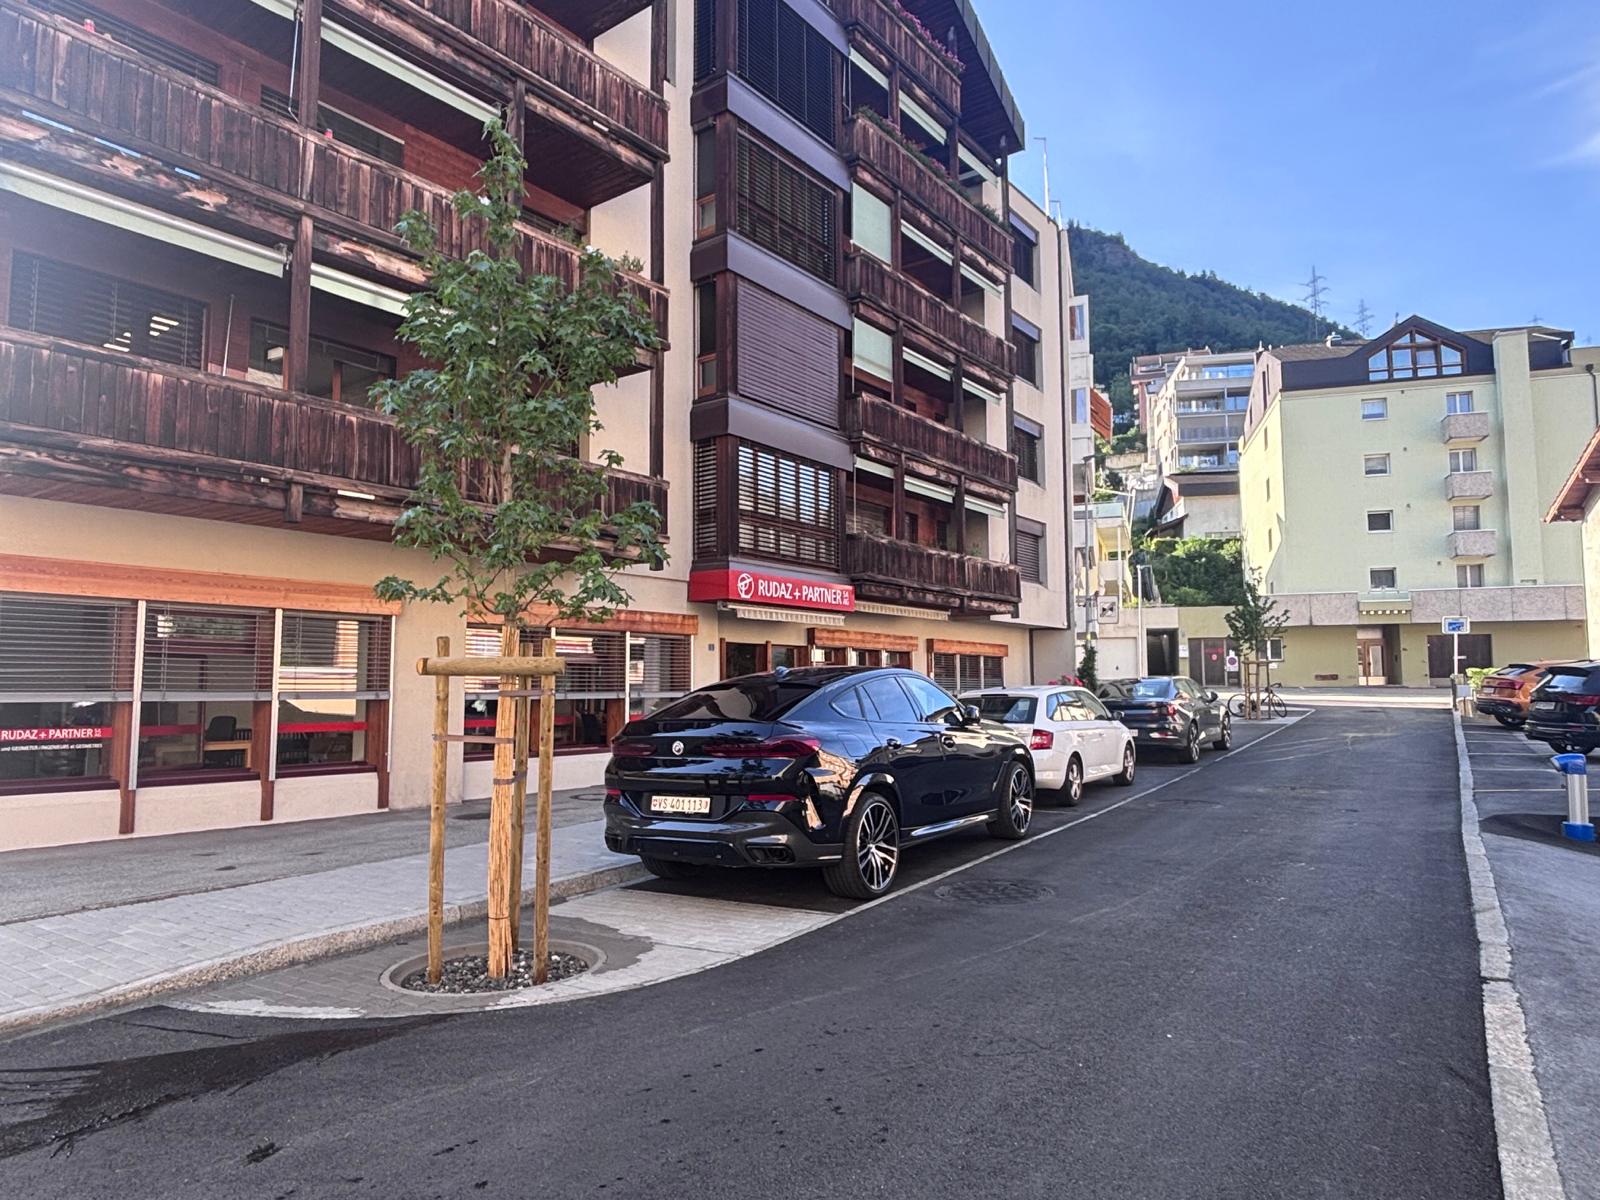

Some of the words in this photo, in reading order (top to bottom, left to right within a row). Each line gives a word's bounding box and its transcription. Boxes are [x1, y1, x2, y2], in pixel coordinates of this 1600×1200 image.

[758, 579, 793, 599] RUDAZ
[802, 585, 842, 605] PARTNER
[1, 729, 38, 740] RUDAZ
[49, 728, 93, 739] PARTNER
